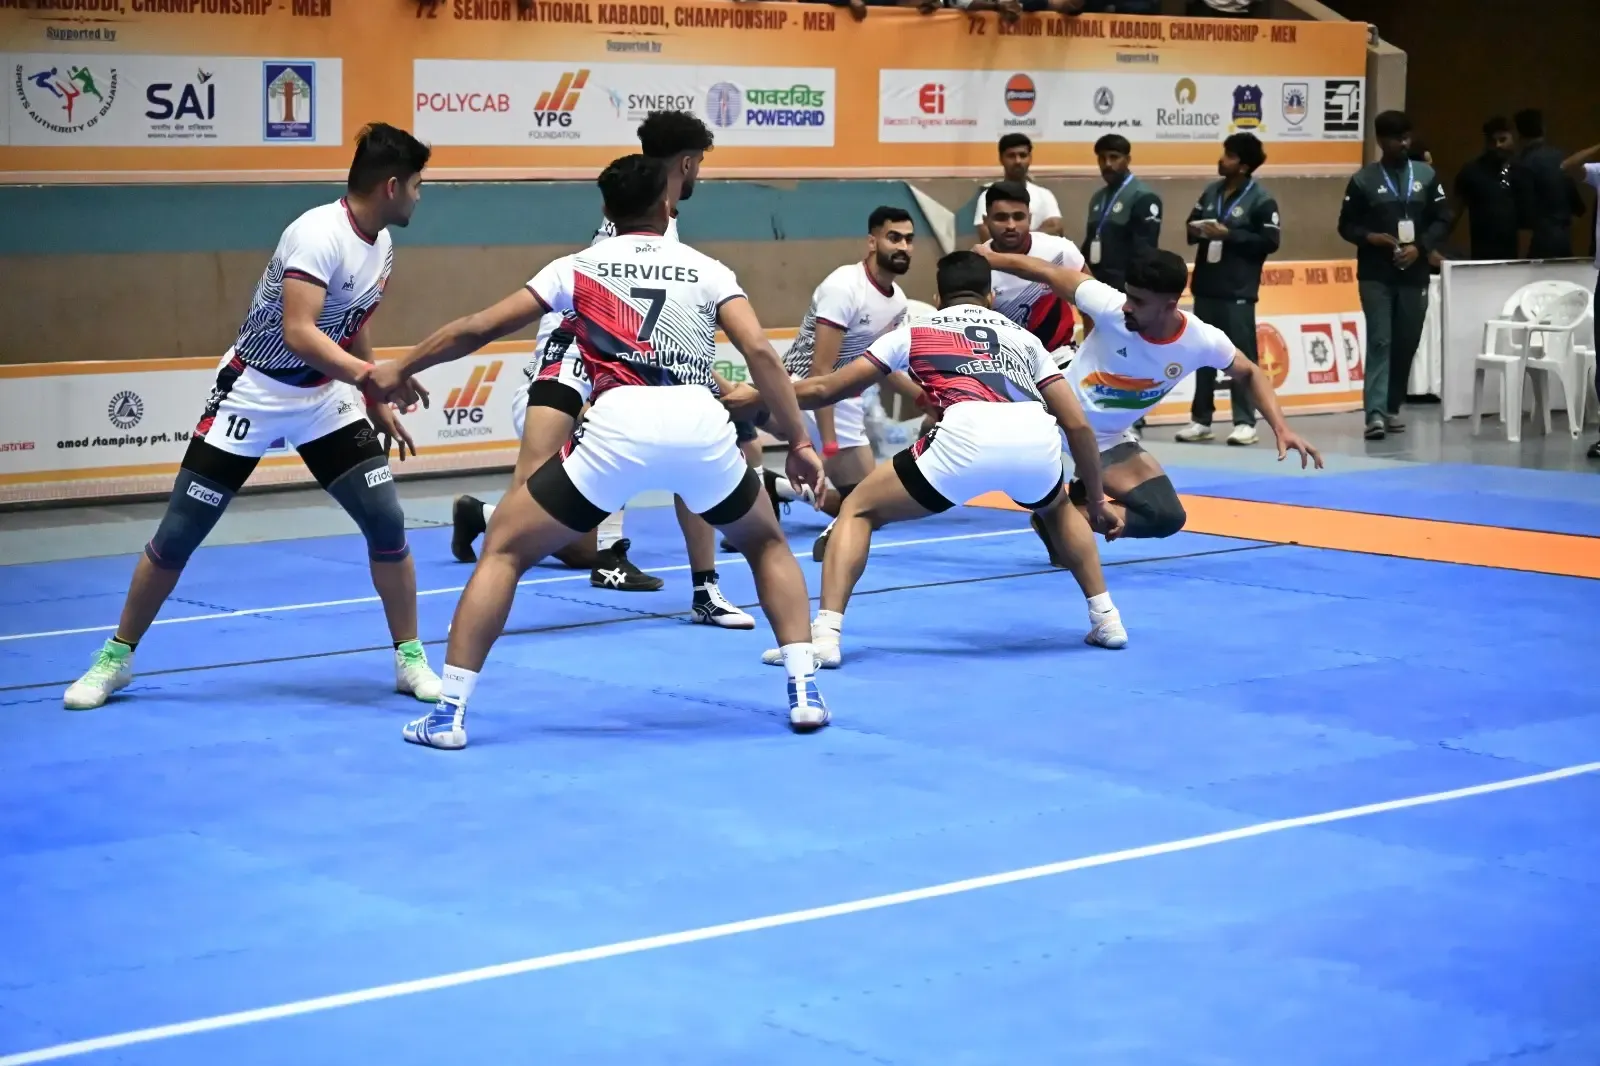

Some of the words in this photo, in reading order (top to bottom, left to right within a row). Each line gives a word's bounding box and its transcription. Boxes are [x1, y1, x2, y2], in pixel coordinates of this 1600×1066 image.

[292, 0, 331, 16] MEN
[454, 1, 511, 21] SENIOR
[517, 2, 592, 23] NATIONAL
[598, 4, 669, 29] KABADDI,
[674, 6, 787, 29] CHAMPIONSHIP
[803, 12, 835, 31] MEN
[46, 27, 100, 40] Supported
[104, 28, 117, 41] by
[968, 16, 986, 35] 72
[1047, 18, 1105, 38] NATIONAL
[1110, 20, 1165, 42] KABADDI,
[1170, 22, 1258, 42] CHAMPIONSHIP
[1271, 25, 1297, 43] MEN
[15, 64, 31, 109] SPORTS
[29, 111, 85, 134] AUTHORITY
[87, 115, 99, 128] OF
[99, 67, 118, 117] GUJARAT
[145, 83, 215, 120] SAI
[416, 93, 510, 112] POLYCAB
[628, 94, 695, 110] SYNERGY
[534, 112, 572, 127] YPG
[746, 109, 825, 126] POWERGRID
[1156, 108, 1220, 126] Reliance
[528, 131, 580, 139] FOUNDATION
[597, 262, 699, 283] SERVICES
[629, 287, 667, 342] 7
[931, 316, 1021, 331] SERVICES
[964, 325, 1000, 358] 9
[443, 407, 484, 426] YPG
[226, 414, 250, 441] 10
[438, 427, 492, 439] FOUNDATION
[57, 436, 88, 449] amod
[92, 434, 148, 448] stampings
[151, 433, 170, 446] pvt.
[189, 484, 220, 505] Frido
